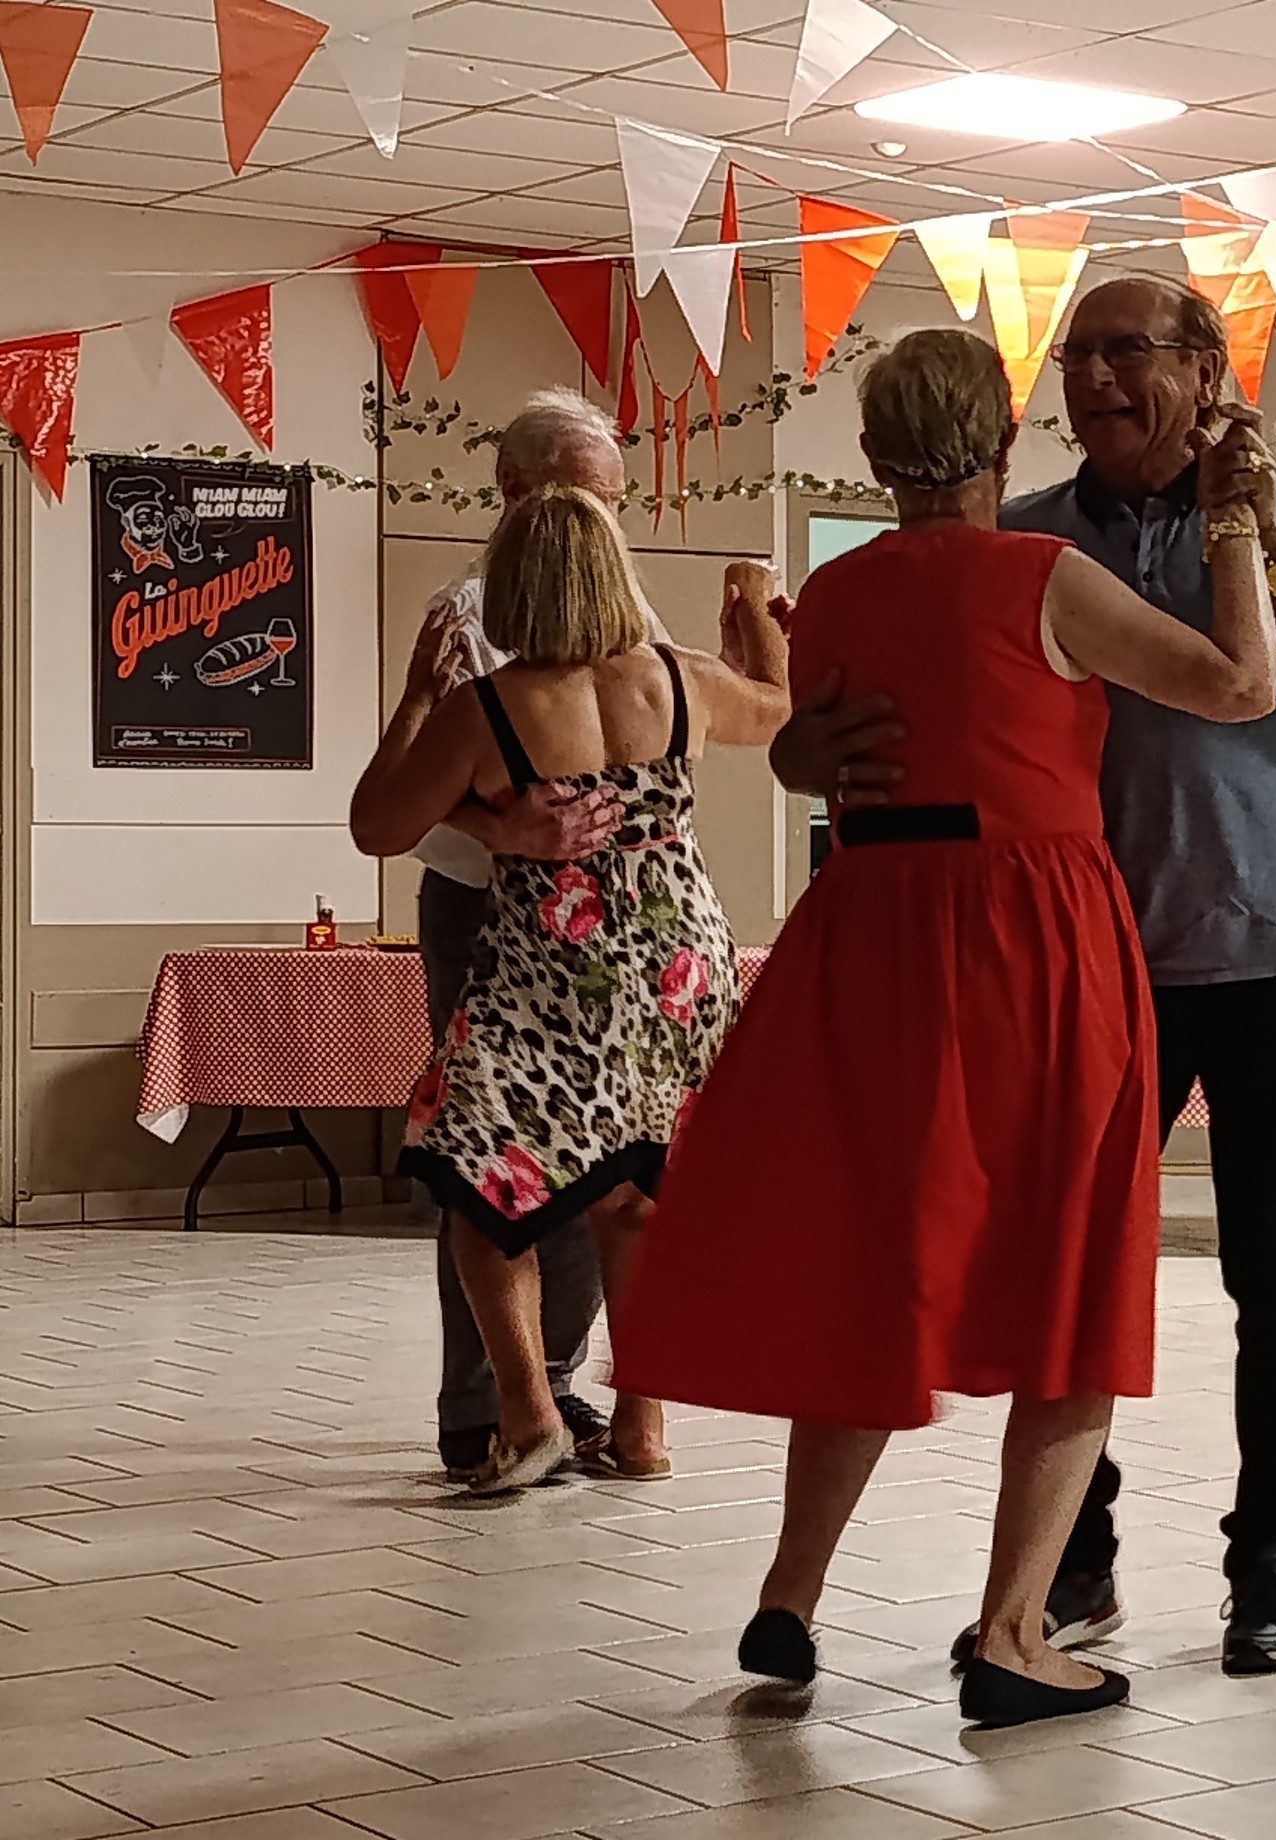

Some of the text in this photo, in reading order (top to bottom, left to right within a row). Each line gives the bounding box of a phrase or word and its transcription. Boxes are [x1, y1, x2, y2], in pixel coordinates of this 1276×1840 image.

[192, 487, 287, 502] MIAM MIAM
[144, 582, 167, 600] La
[111, 536, 294, 679] Guinguette
